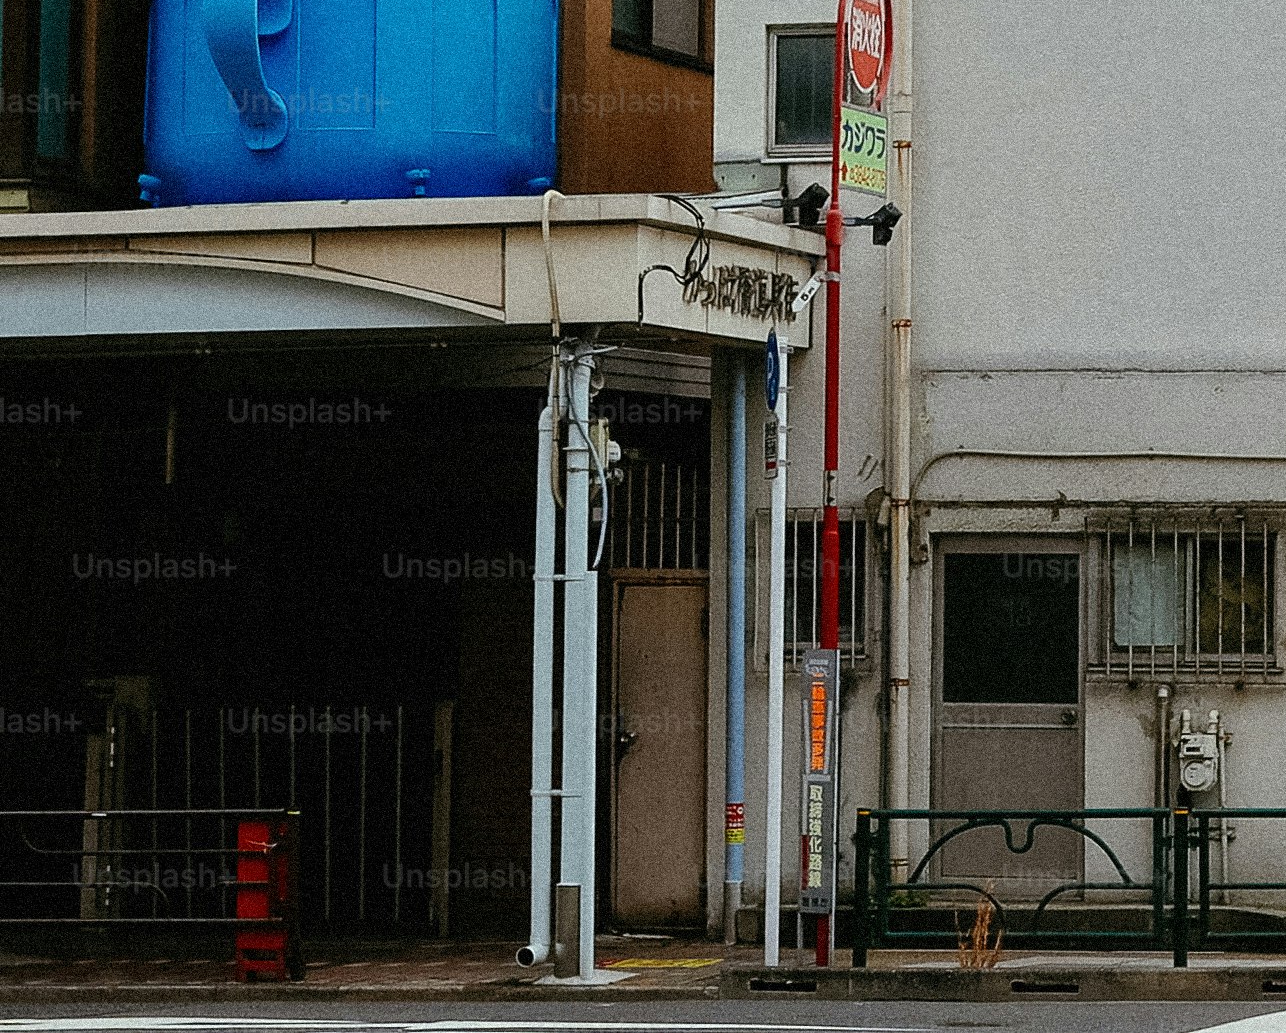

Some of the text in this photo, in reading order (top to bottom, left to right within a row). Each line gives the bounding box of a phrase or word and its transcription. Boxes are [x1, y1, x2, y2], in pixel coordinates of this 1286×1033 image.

[851, 8, 882, 58] 消火栓
[841, 118, 886, 159] カジワラ
